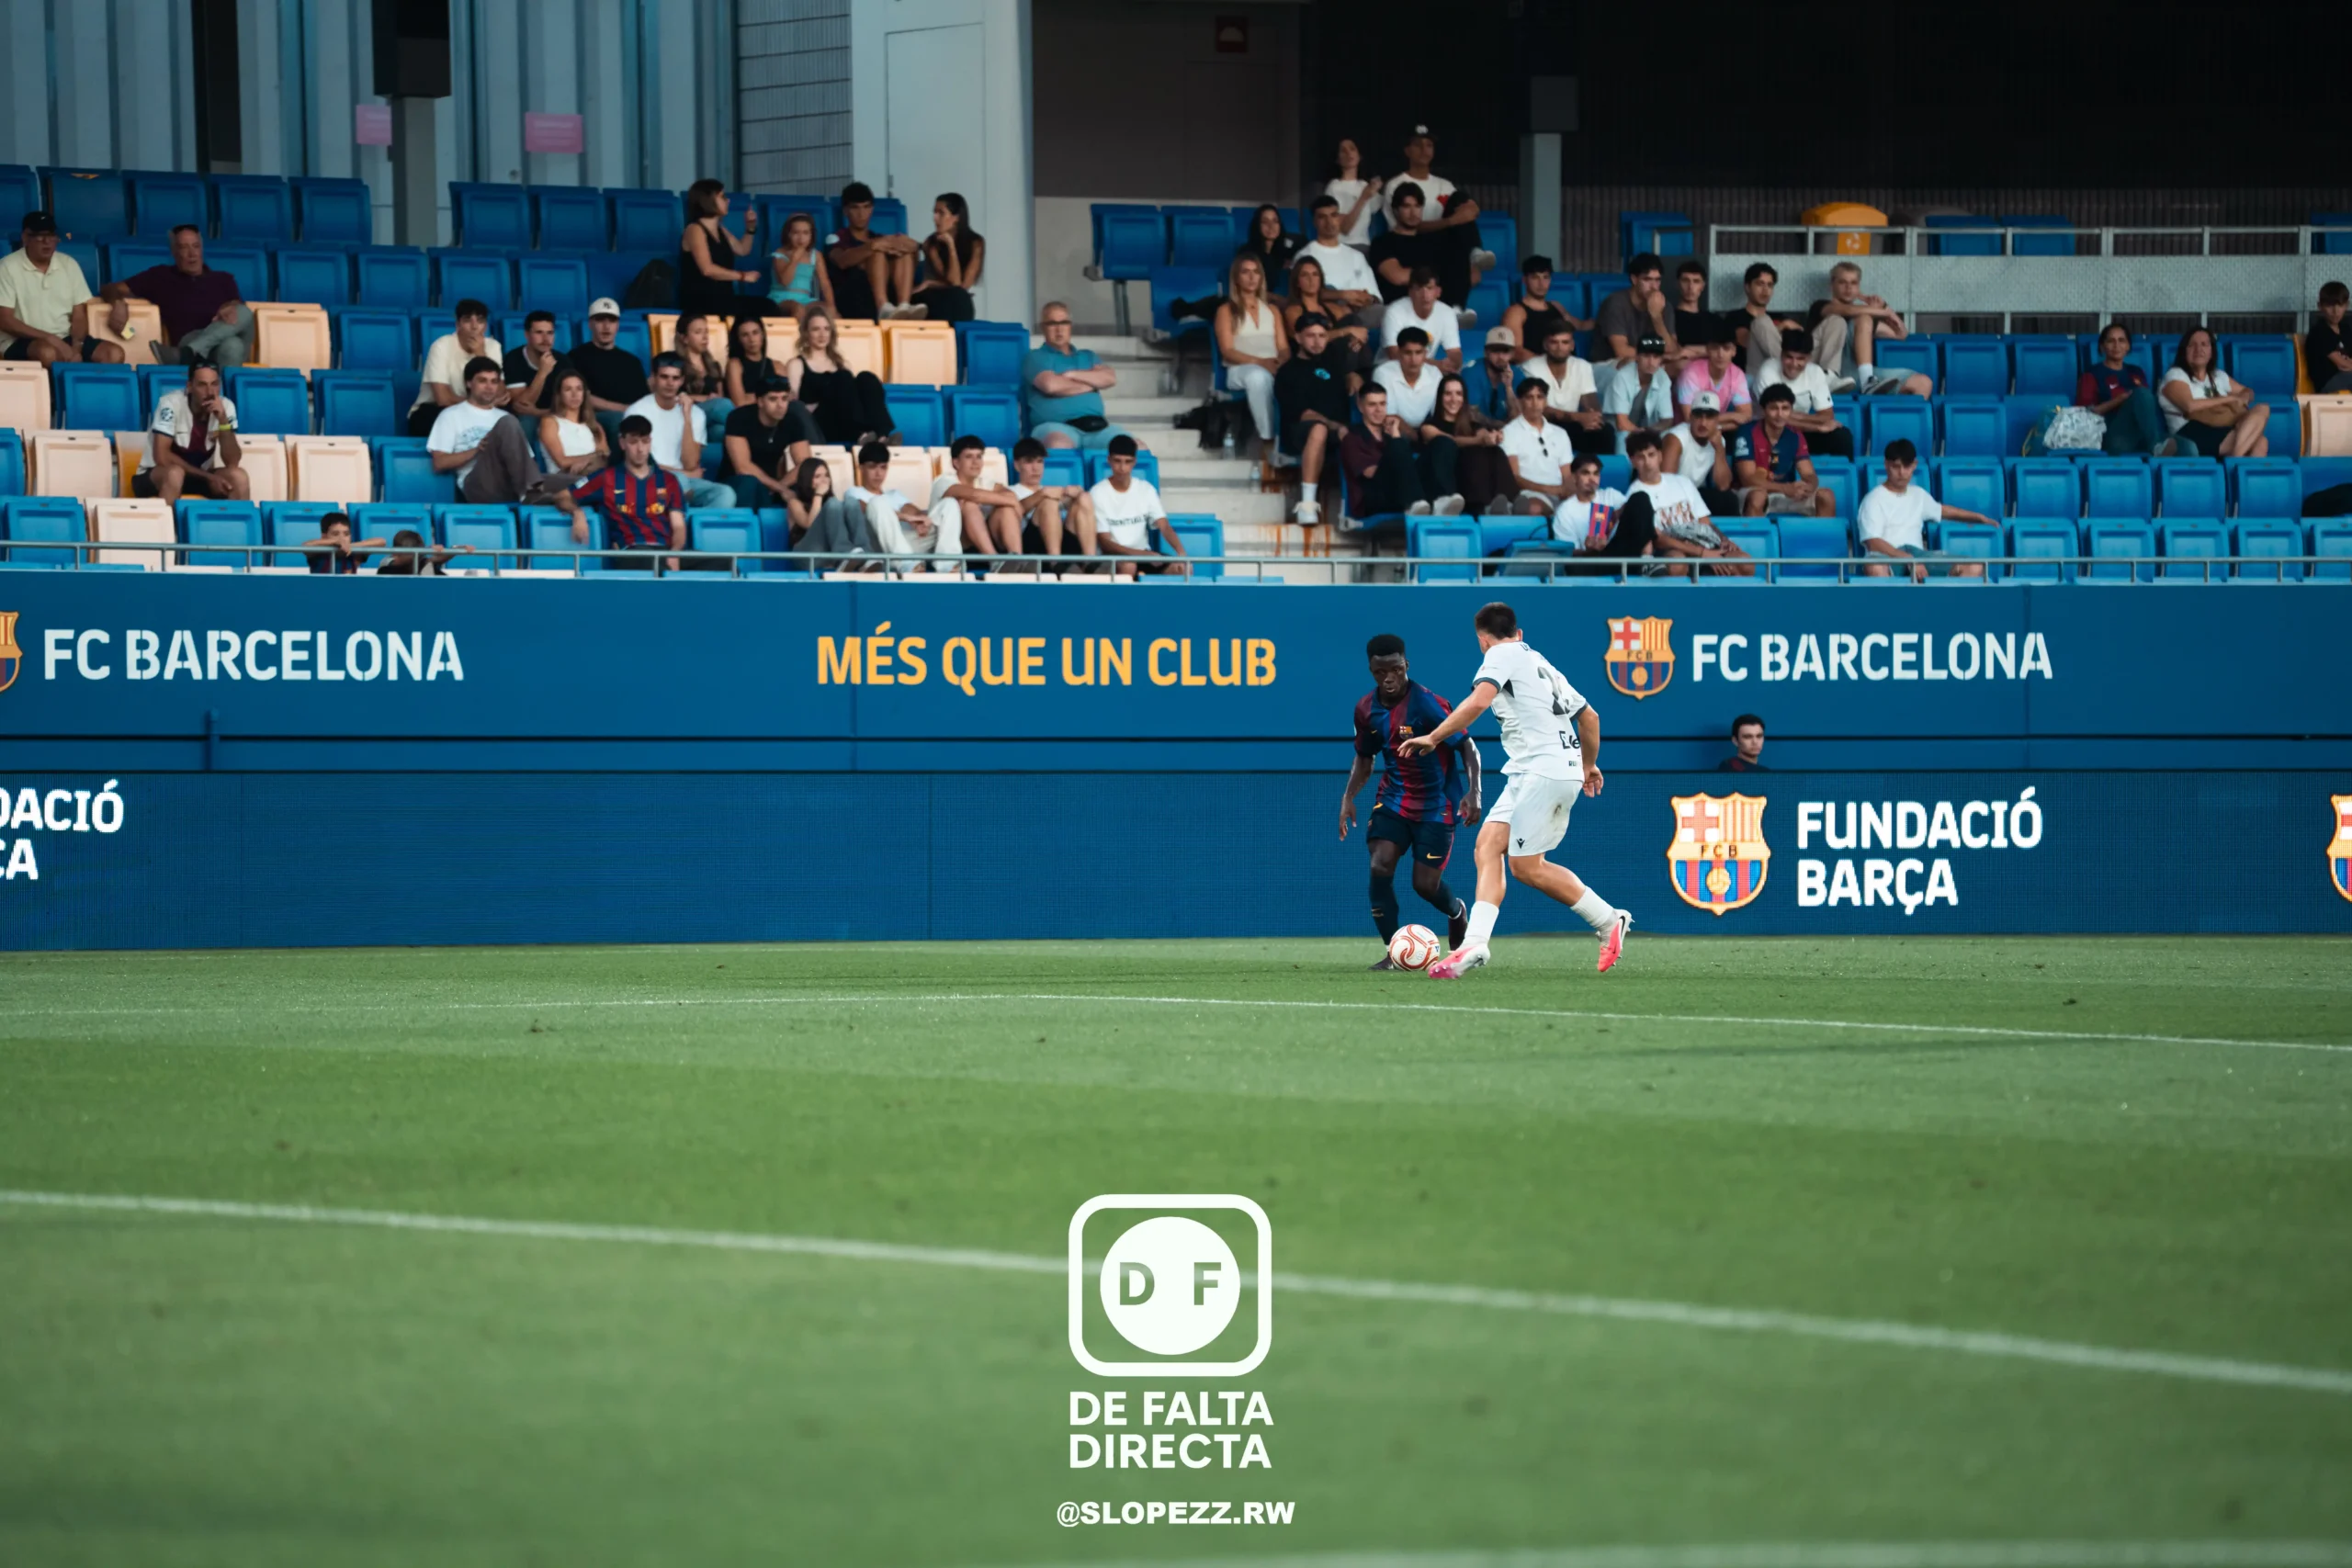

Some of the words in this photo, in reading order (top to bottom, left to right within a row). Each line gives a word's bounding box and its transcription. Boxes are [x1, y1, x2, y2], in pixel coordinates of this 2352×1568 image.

[44, 629, 110, 681] FC
[126, 629, 464, 682] BARCELONA
[817, 621, 927, 685] MÉS
[942, 637, 1046, 696] QUE
[1062, 637, 1132, 686] UN
[1148, 637, 1276, 686] CLUB
[1693, 634, 1747, 682] FC
[1760, 632, 2052, 681] BARCELONA
[1797, 786, 2043, 850] FUNDACIÓ
[0, 839, 39, 880] A
[1701, 844, 1738, 859] FCB
[1797, 859, 1959, 916] BARÇA
